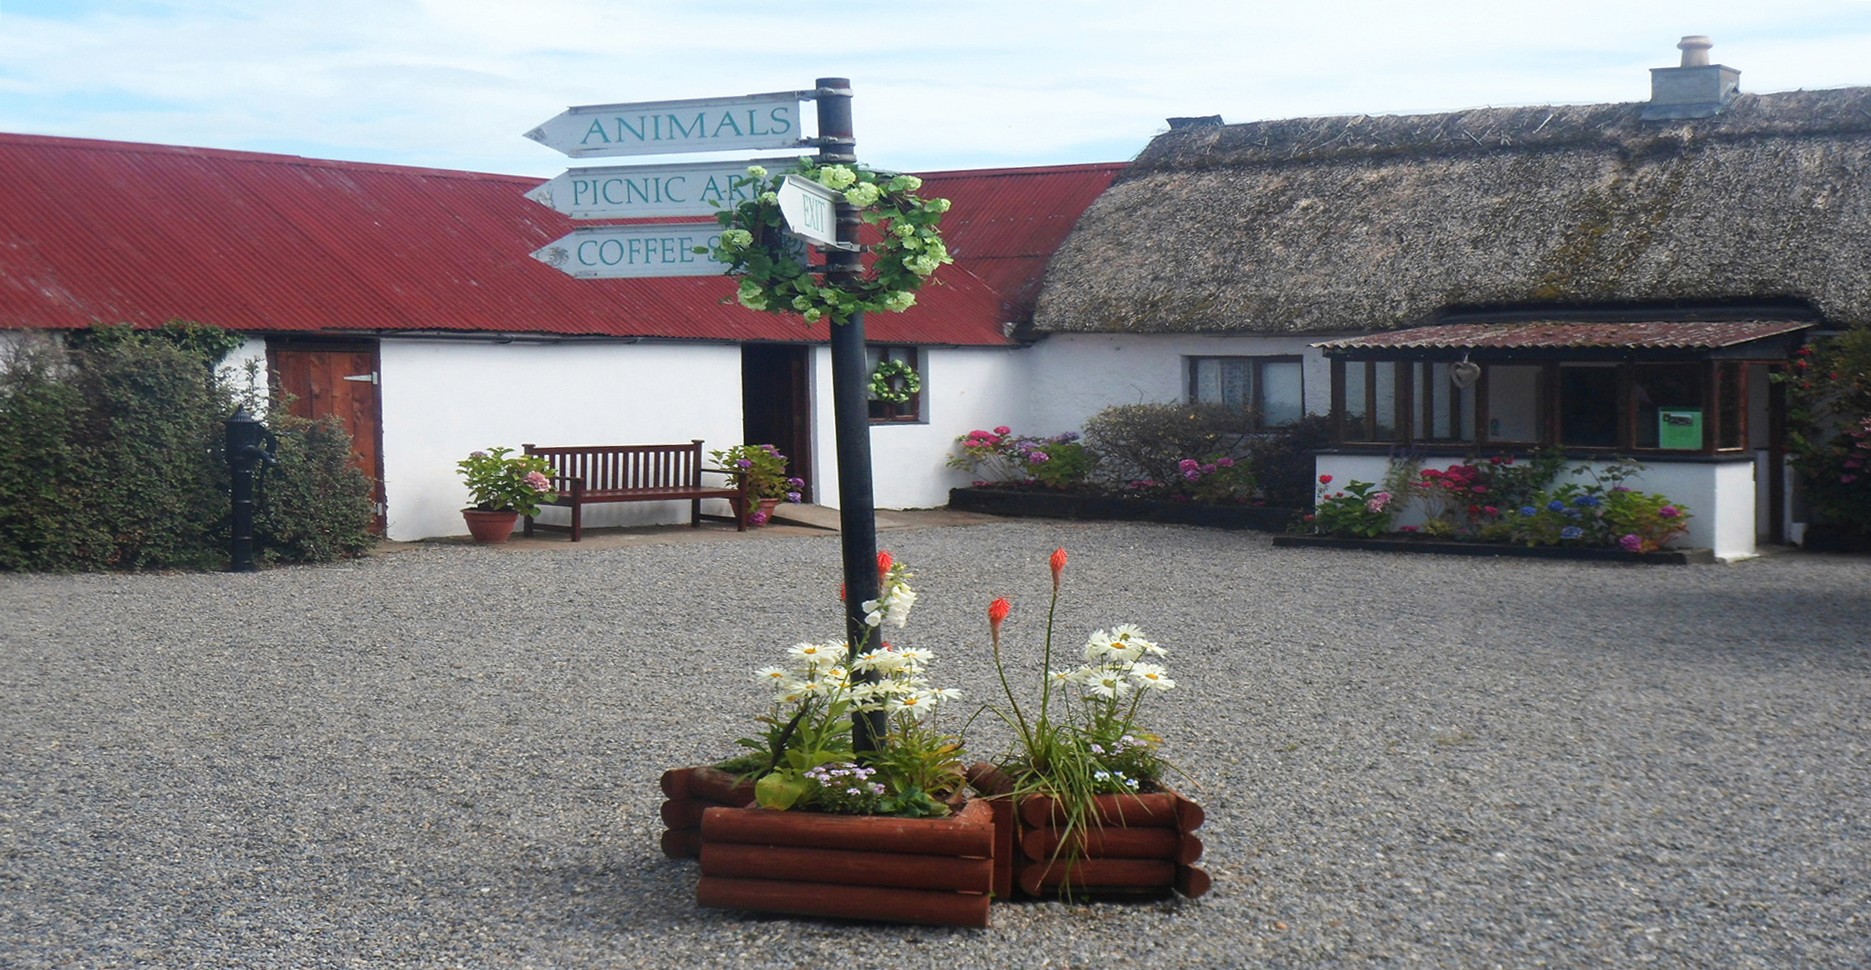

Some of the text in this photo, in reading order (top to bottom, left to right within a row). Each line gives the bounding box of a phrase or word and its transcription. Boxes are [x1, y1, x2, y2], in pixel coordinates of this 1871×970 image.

[581, 106, 791, 145] ANIMALS
[572, 176, 686, 206] PICNIC
[802, 193, 825, 235] EXIT
[577, 237, 693, 266] COFFEE
